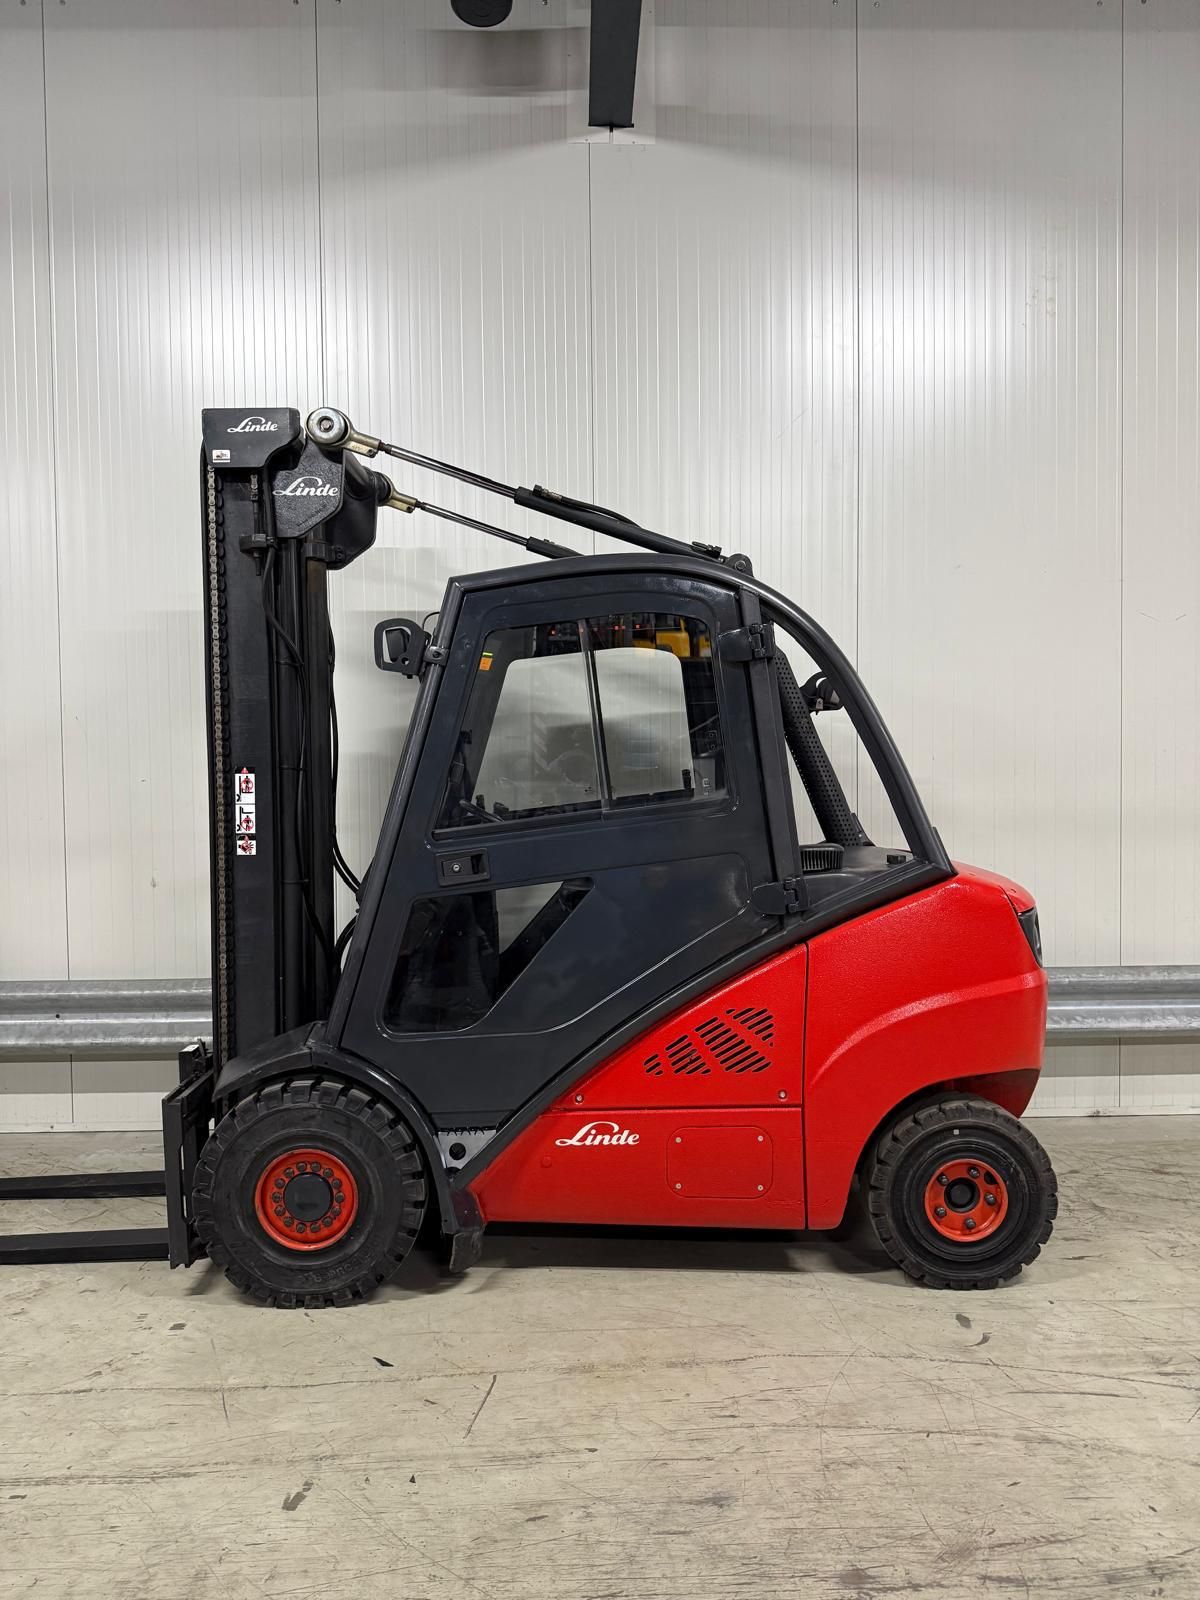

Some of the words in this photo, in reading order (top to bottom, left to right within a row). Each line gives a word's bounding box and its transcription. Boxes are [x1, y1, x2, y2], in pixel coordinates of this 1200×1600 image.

[227, 416, 279, 432] Linde
[273, 476, 339, 496] Linde
[555, 1121, 640, 1146] Linde
